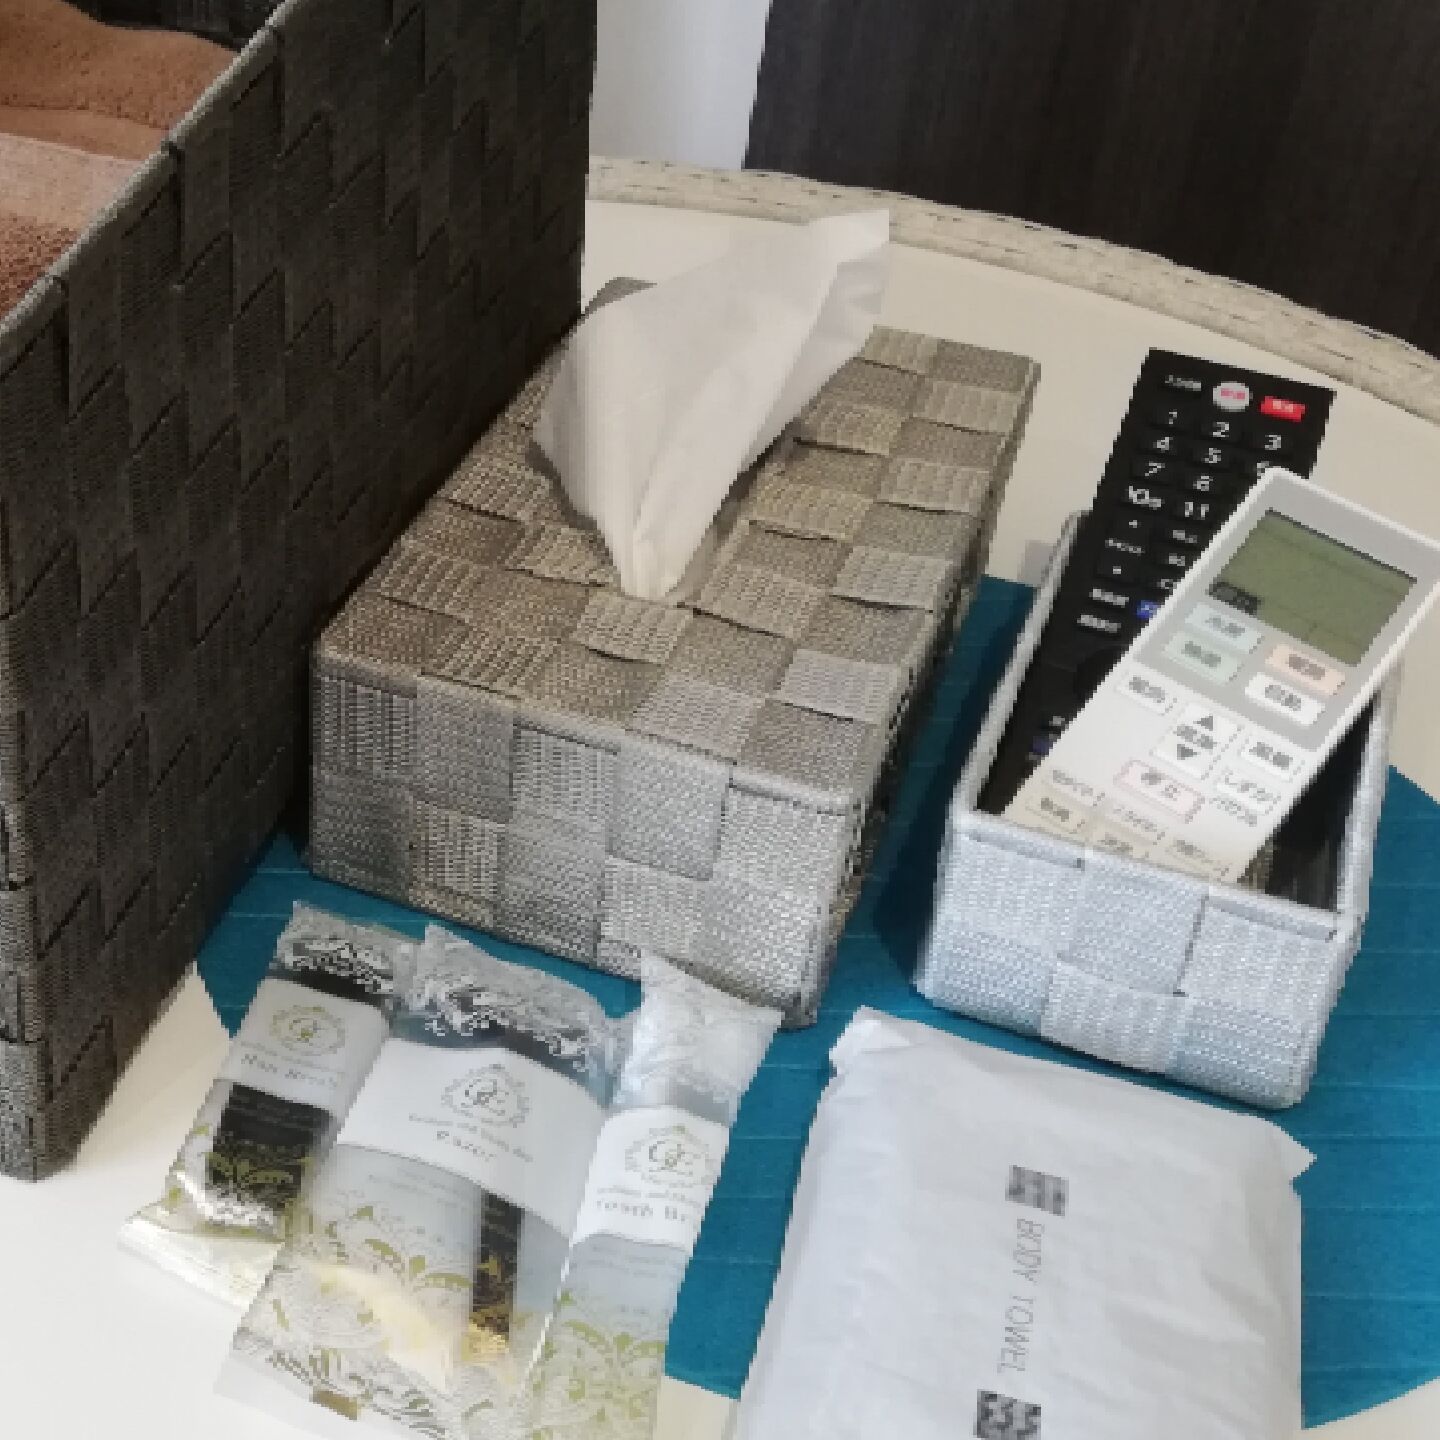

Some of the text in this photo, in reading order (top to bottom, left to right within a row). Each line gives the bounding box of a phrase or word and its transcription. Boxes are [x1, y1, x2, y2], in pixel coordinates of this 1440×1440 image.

[1155, 435, 1172, 452] 4
[1204, 447, 1222, 464] 5
[1212, 421, 1230, 438] 2
[1263, 434, 1282, 451] 3
[1144, 461, 1165, 478] 7
[997, 1217, 1045, 1376] BODY TOWEL
